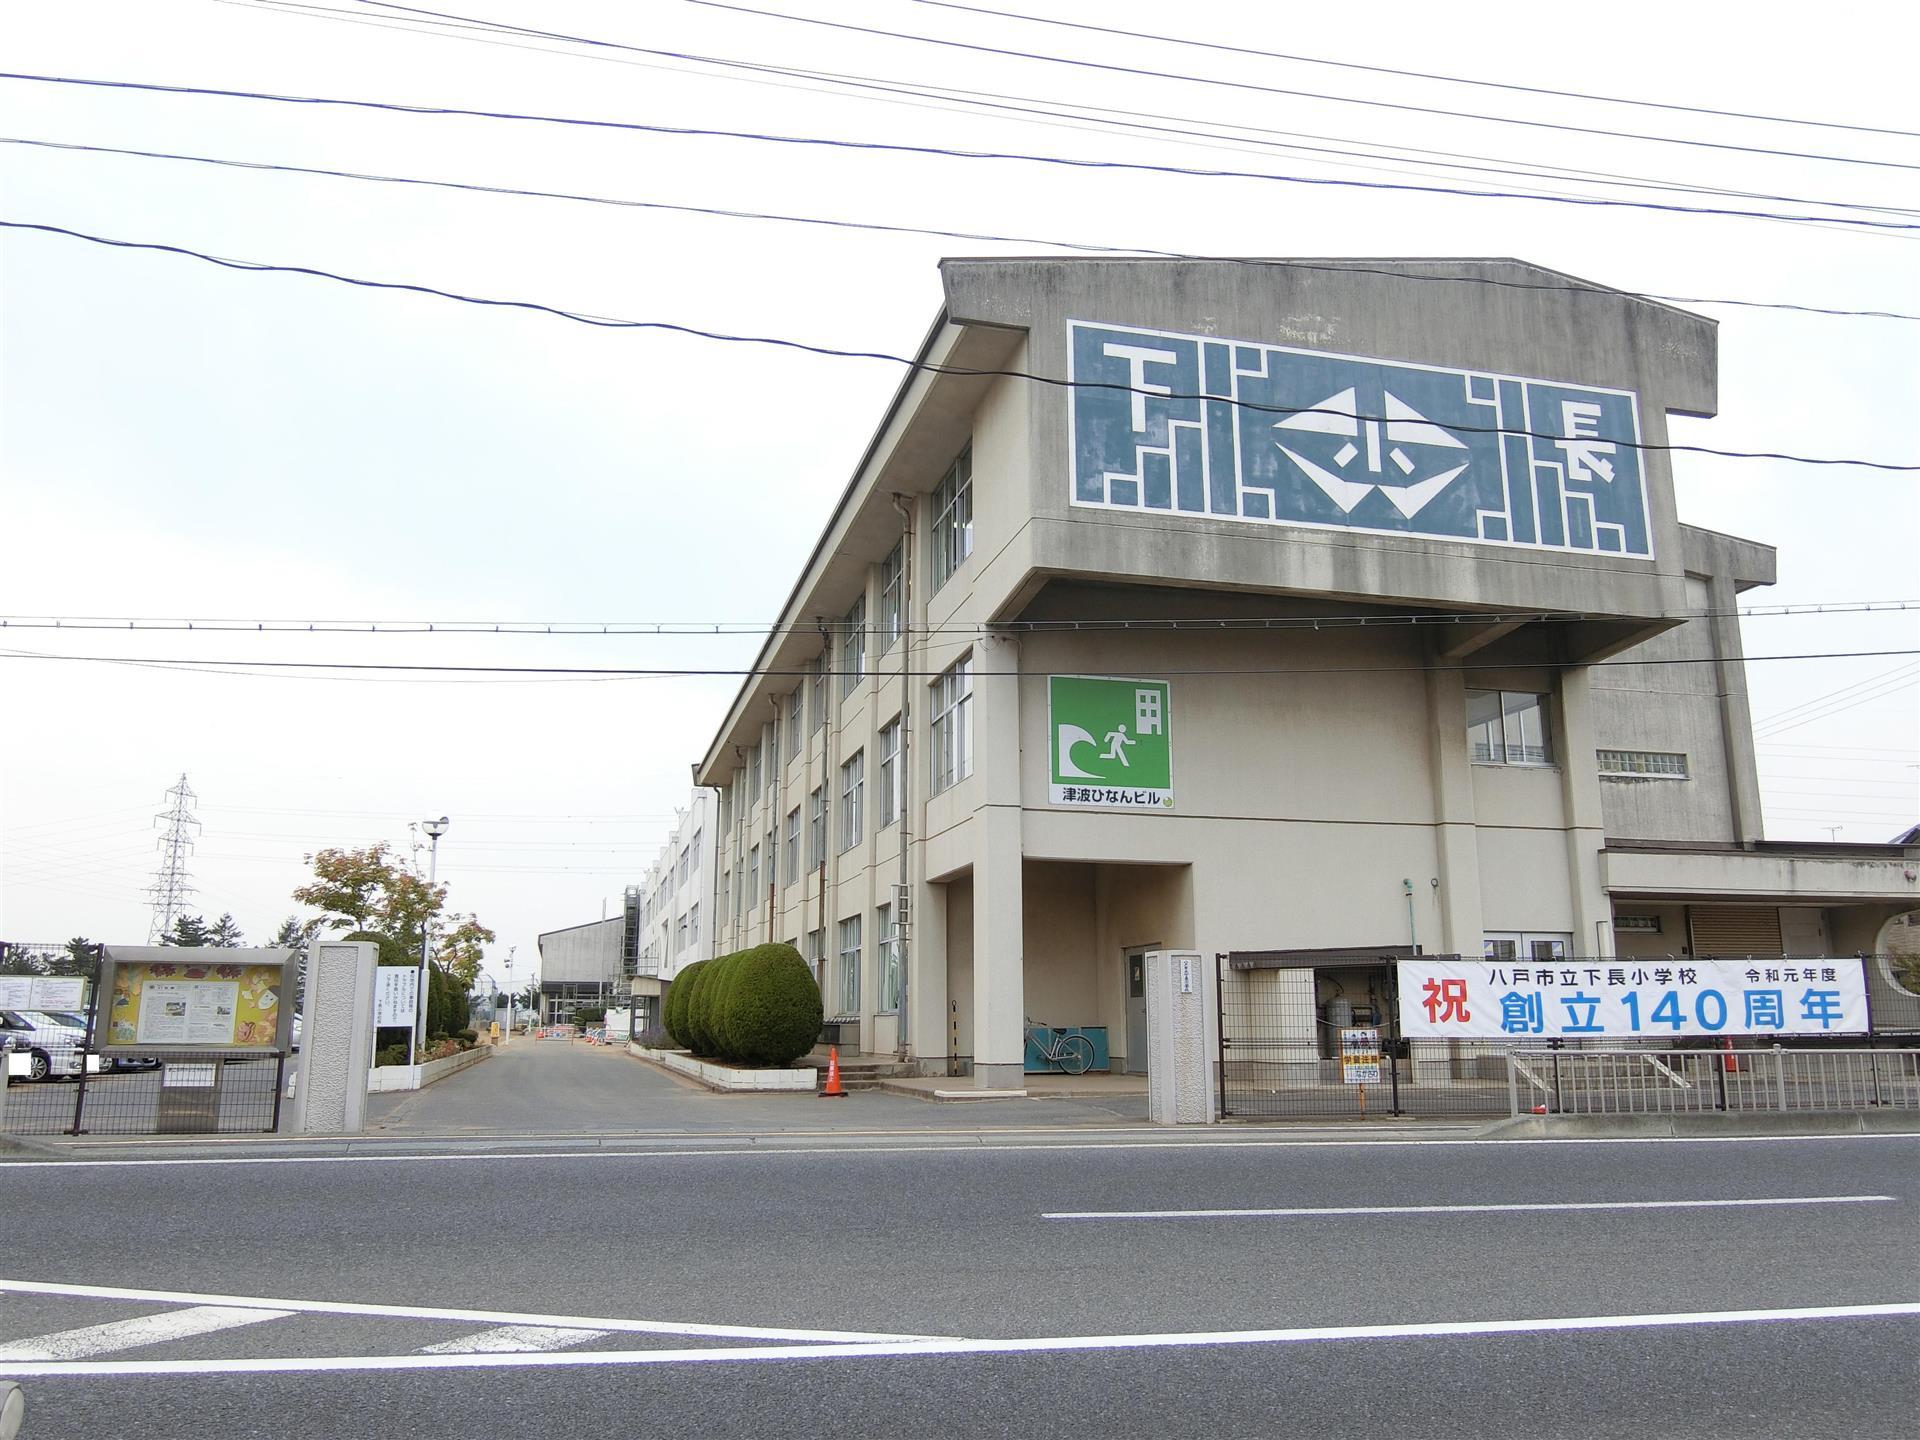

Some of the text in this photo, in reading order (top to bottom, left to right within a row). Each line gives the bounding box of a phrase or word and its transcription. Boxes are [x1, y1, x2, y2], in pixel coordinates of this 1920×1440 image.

[1062, 786, 1161, 805] 津波ひなんビル
[1489, 967, 1698, 987] 八戸市立下長小学校
[1744, 967, 1838, 984] 令和元年度
[1422, 977, 1471, 1024] 祝
[1499, 987, 1844, 1034] 創立140周年
